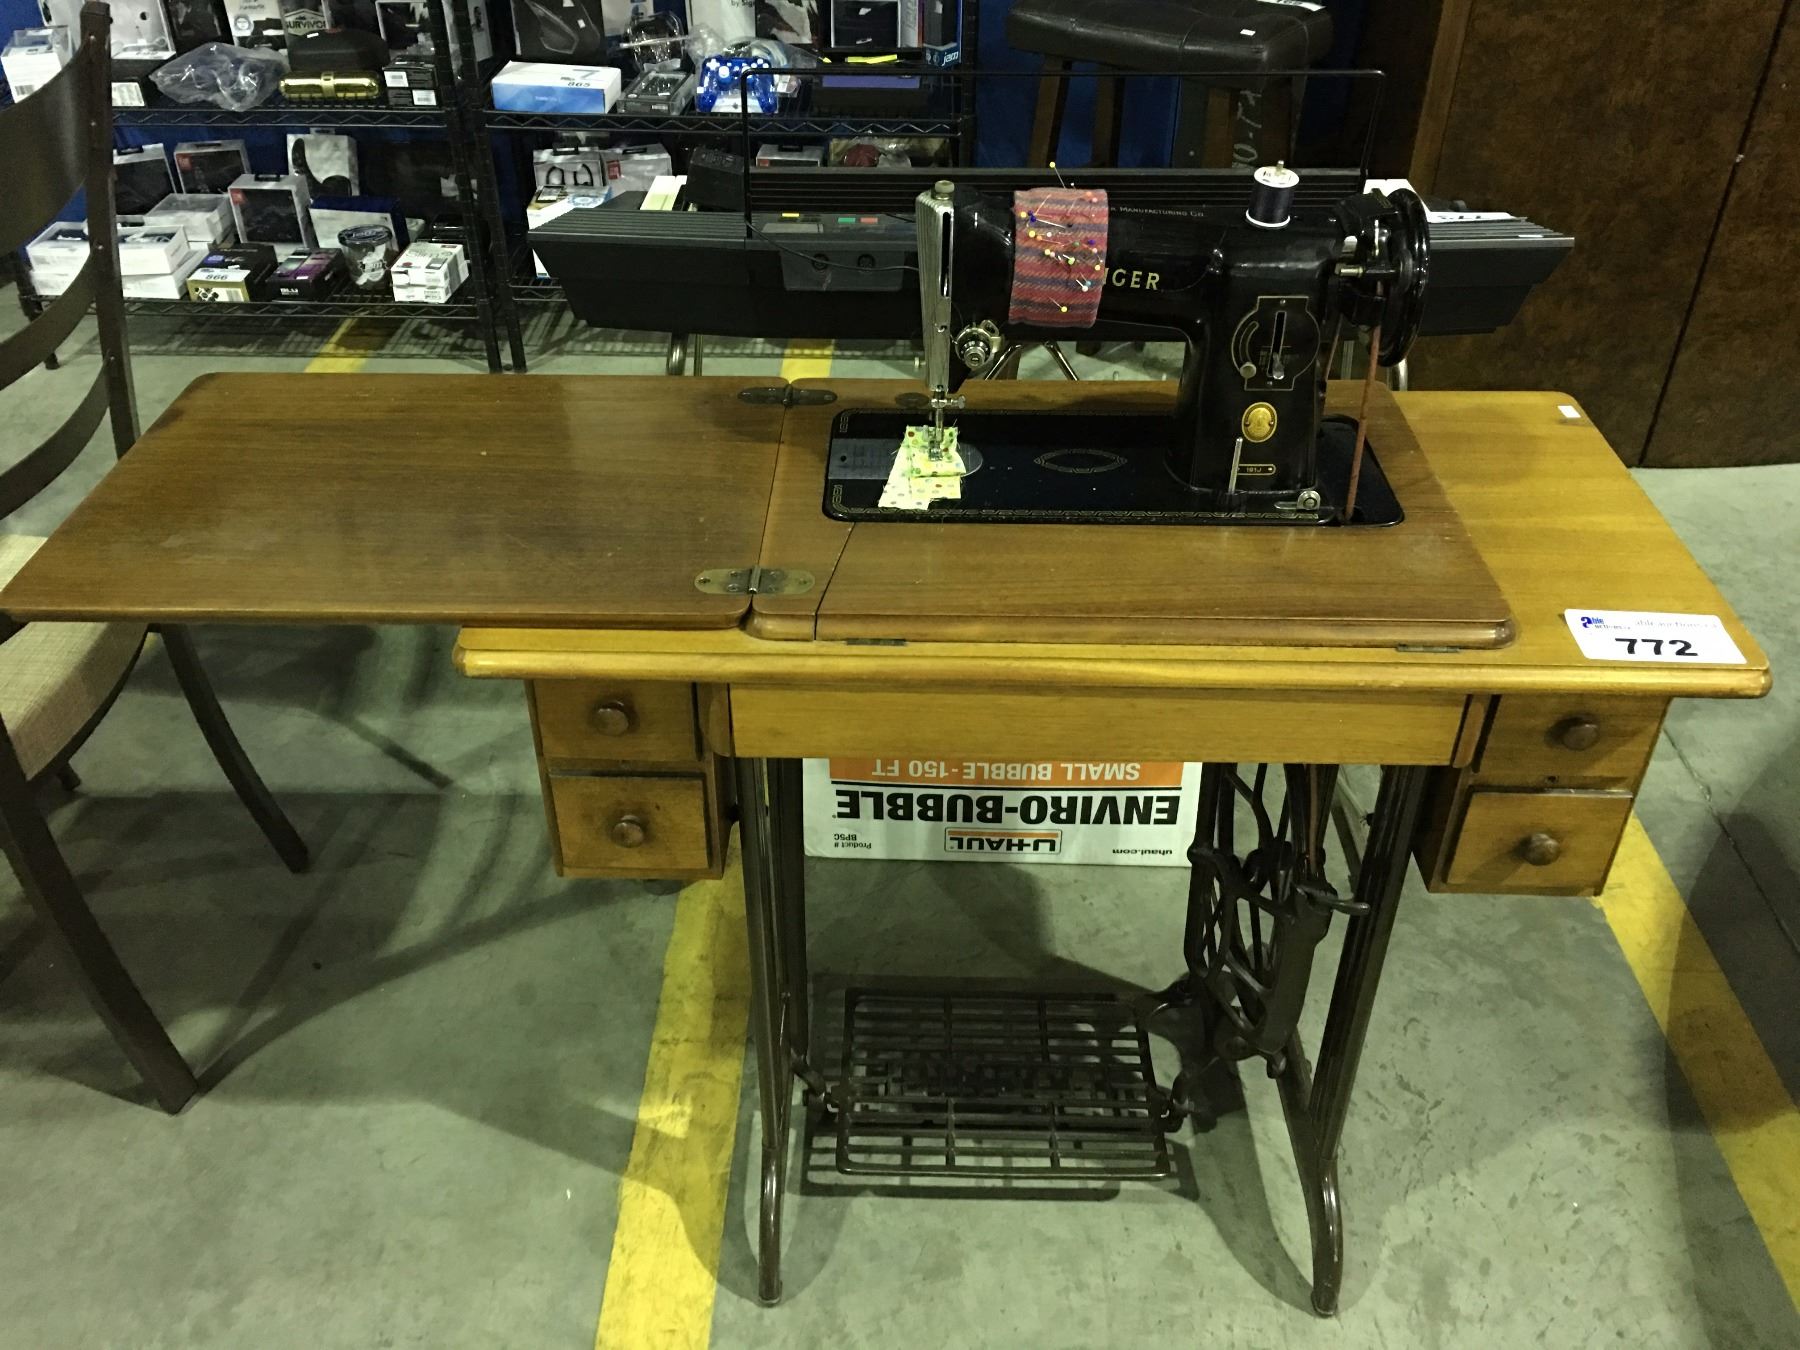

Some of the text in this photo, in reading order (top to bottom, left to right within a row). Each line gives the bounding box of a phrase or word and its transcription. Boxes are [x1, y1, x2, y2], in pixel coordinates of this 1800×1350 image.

[942, 51, 959, 66] jam
[1614, 637, 1698, 656] 772
[871, 759, 900, 776] FT
[962, 762, 1052, 780] BUBBLE
[1060, 763, 1141, 781] SMALL
[835, 789, 1181, 825] ENVIRO-BUBBLE
[841, 841, 872, 849] Product
[949, 836, 1057, 852] U-HAUL
[1112, 848, 1173, 856] uhaul.com
